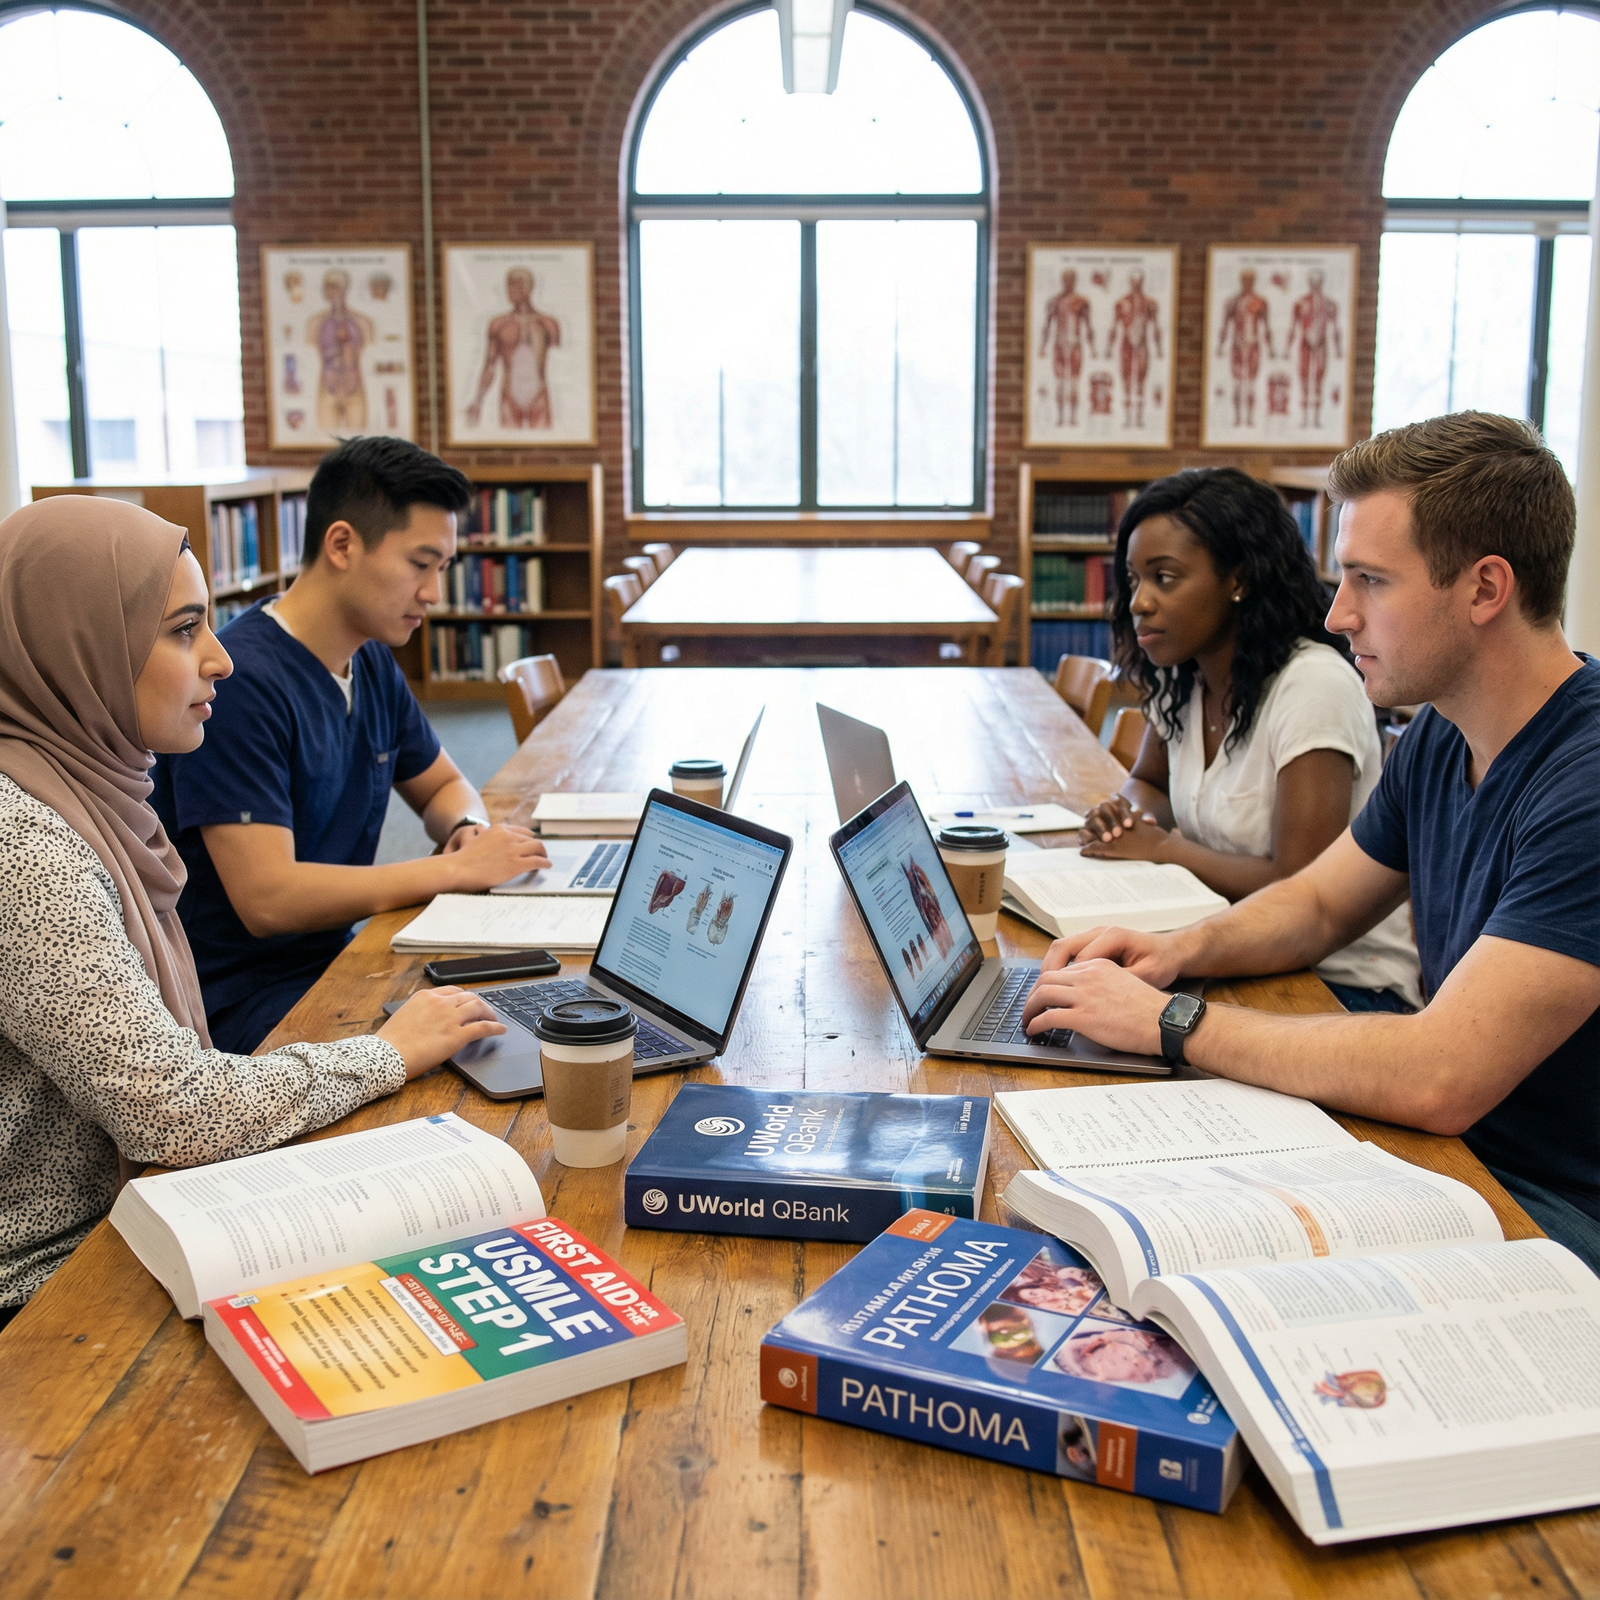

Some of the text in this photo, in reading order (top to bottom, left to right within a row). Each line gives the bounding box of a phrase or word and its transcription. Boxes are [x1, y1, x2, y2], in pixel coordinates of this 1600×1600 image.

[744, 1105, 794, 1156] UWorld
[783, 1108, 828, 1156] QBank
[678, 1194, 850, 1223] UWorld QBank
[418, 1252, 528, 1329] STEP
[499, 1332, 554, 1357] 1
[522, 1221, 659, 1320] FIRST AID FOR
[862, 1240, 1009, 1350] PATHOMA
[841, 1378, 1031, 1452] PATHOMA
